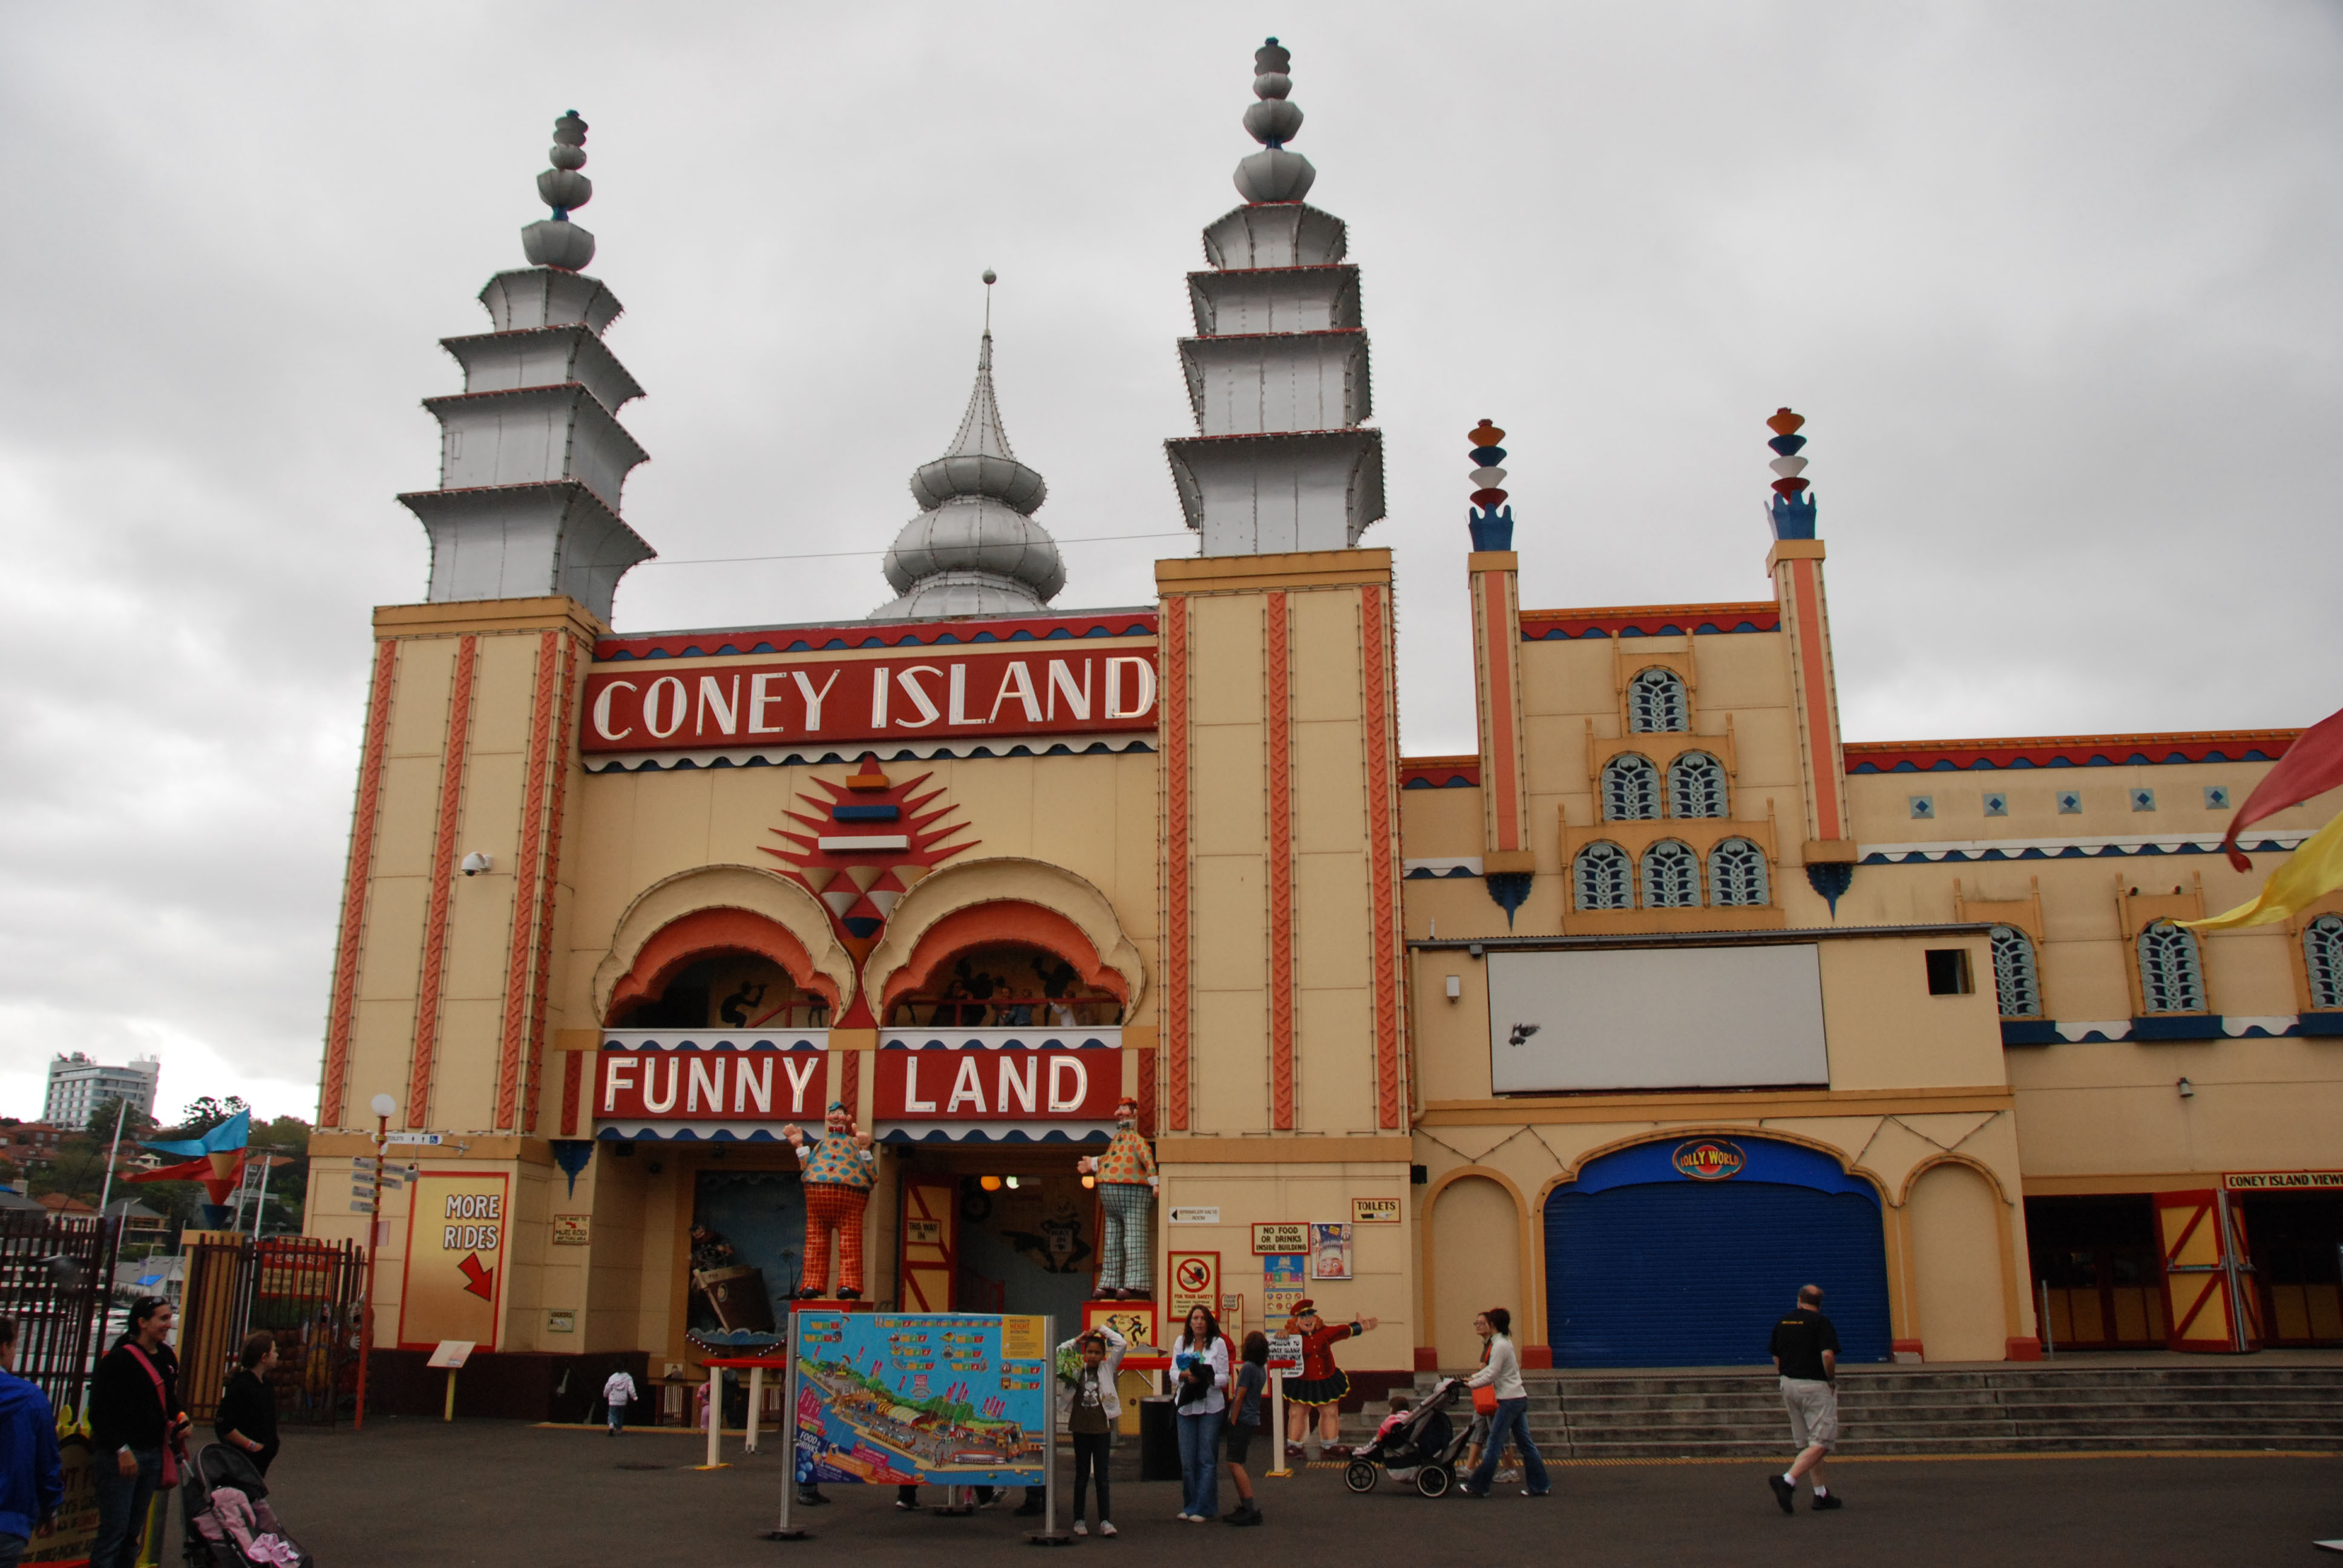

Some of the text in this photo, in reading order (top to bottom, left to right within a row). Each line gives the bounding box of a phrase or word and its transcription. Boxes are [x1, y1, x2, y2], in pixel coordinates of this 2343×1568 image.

[592, 656, 1157, 740] CONEY ISLAND
[604, 1056, 819, 1113] FUNNY
[905, 1055, 1088, 1113] LAND
[1680, 1151, 1739, 1167] LOLLY WORLD
[2229, 1175, 2266, 1187] CONEY
[2269, 1175, 2309, 1186] ISLAND
[445, 1194, 500, 1219] MORE
[1357, 1201, 1396, 1210] TOILETS
[909, 1221, 937, 1232] THIS WAY
[444, 1225, 499, 1251] RIDES
[917, 1231, 926, 1240] IN
[799, 1431, 818, 1445] FOOD
